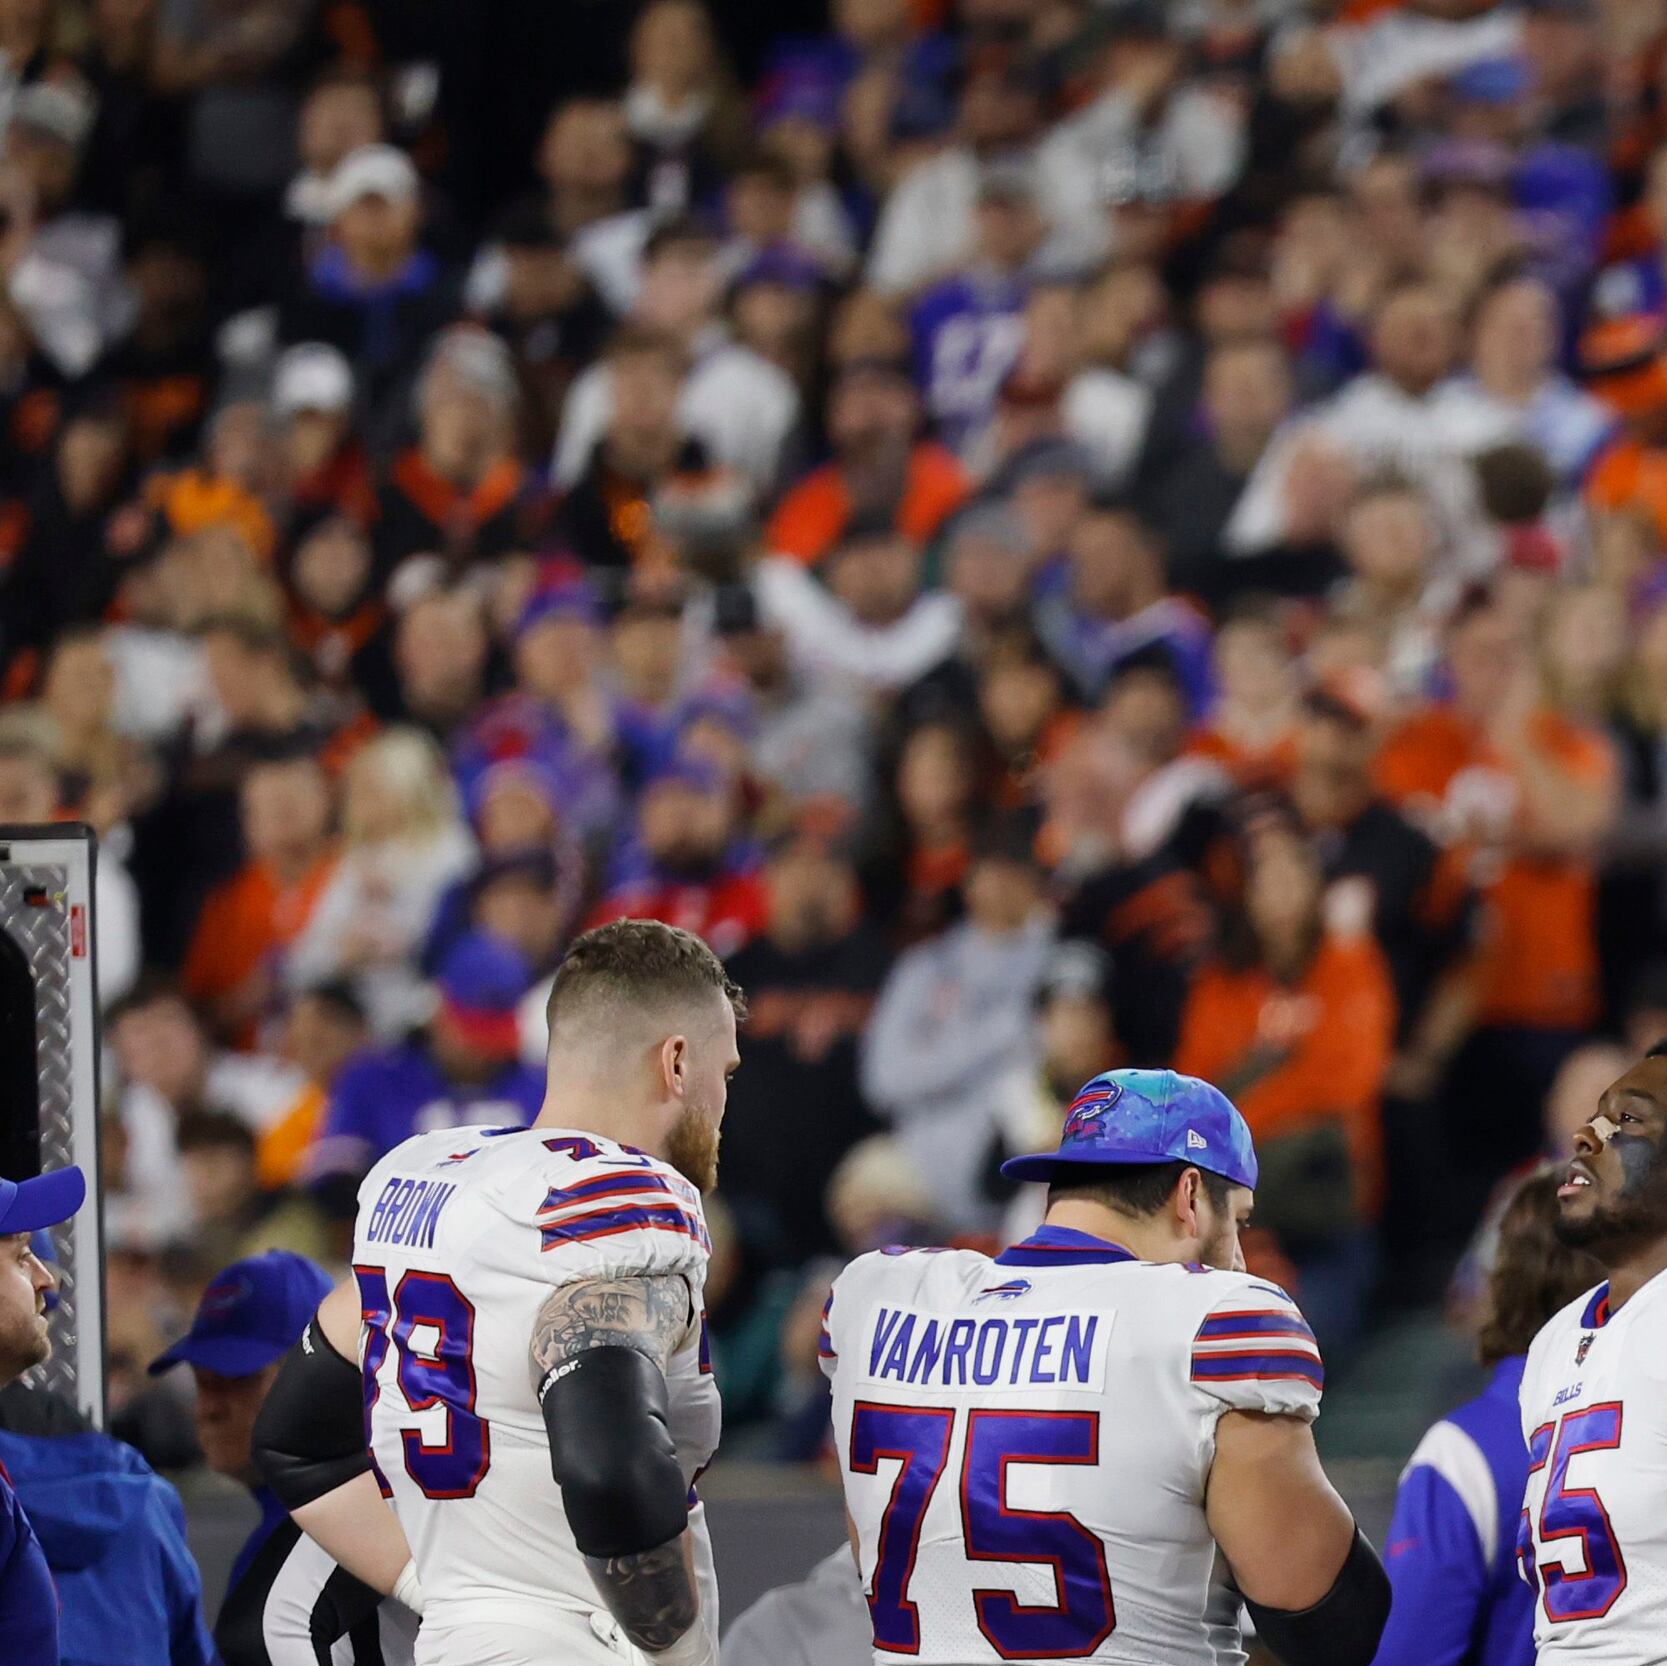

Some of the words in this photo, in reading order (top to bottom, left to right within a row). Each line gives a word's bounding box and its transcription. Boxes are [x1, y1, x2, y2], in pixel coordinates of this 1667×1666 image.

[366, 1176, 456, 1249] BROWN
[868, 1307, 1099, 1386] VANROTEN
[1552, 1382, 1583, 1406] BILLS
[849, 1400, 1116, 1660] 75
